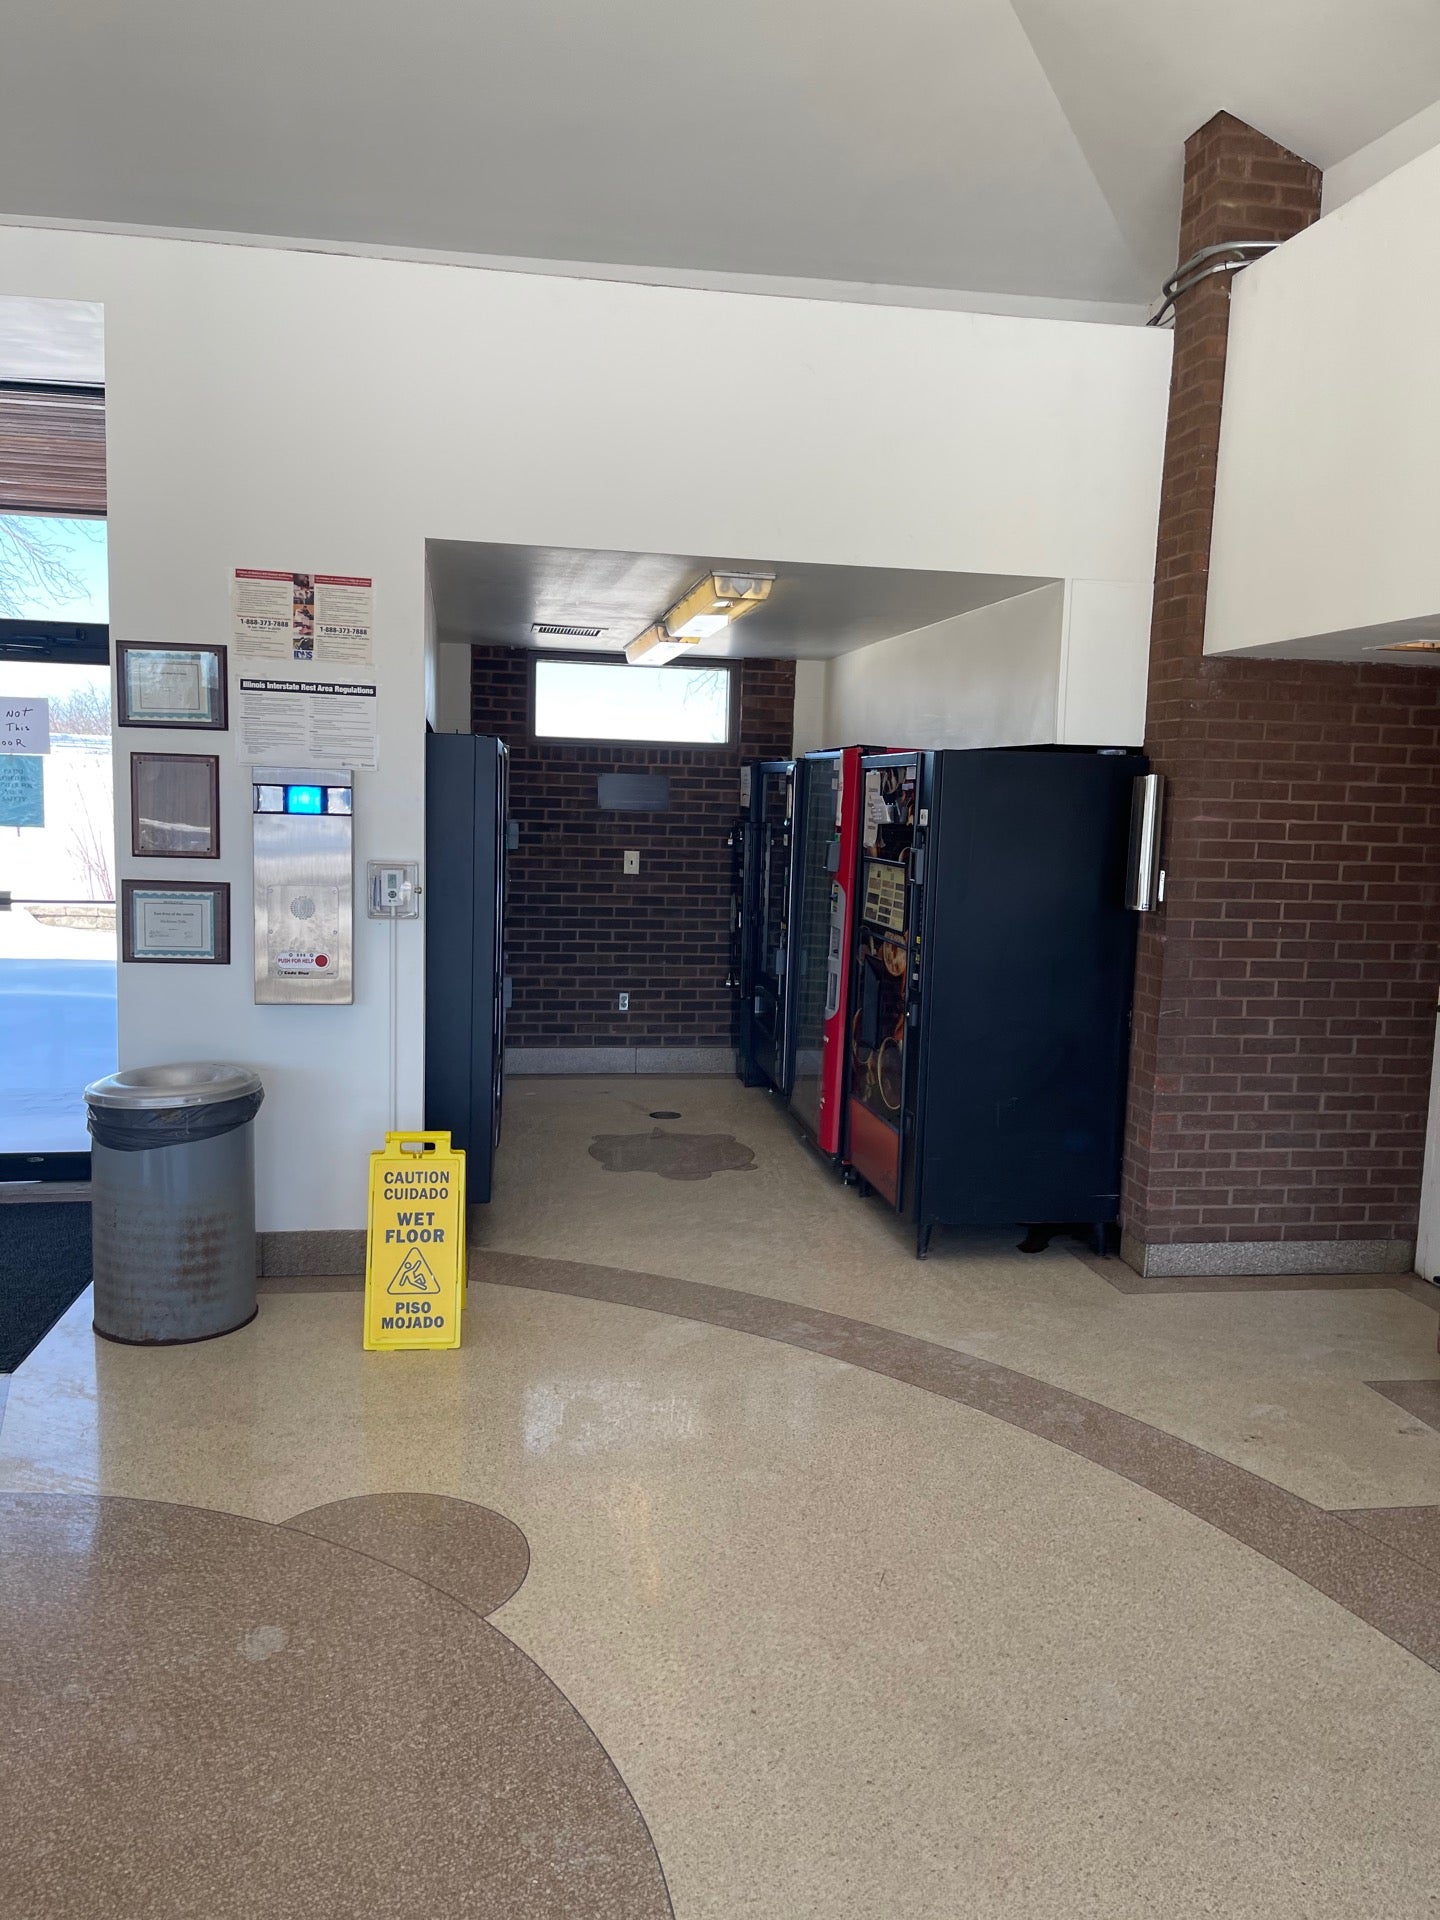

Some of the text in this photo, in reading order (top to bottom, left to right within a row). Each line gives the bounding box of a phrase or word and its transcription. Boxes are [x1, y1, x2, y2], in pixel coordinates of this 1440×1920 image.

[240, 618, 289, 628] 1-888-373-7888
[319, 626, 368, 635] 1-888-373-7888
[242, 680, 266, 688] Illinois
[267, 682, 300, 690] Interstate
[301, 683, 317, 691] Rest
[334, 685, 374, 695] Regulations
[384, 1171, 450, 1184] CAUTION
[384, 1187, 449, 1200] CUIDADO
[397, 1212, 435, 1226] WET
[385, 1229, 444, 1243] FLOOR
[396, 1301, 431, 1314] PISO
[381, 1316, 444, 1329] MOJADO
